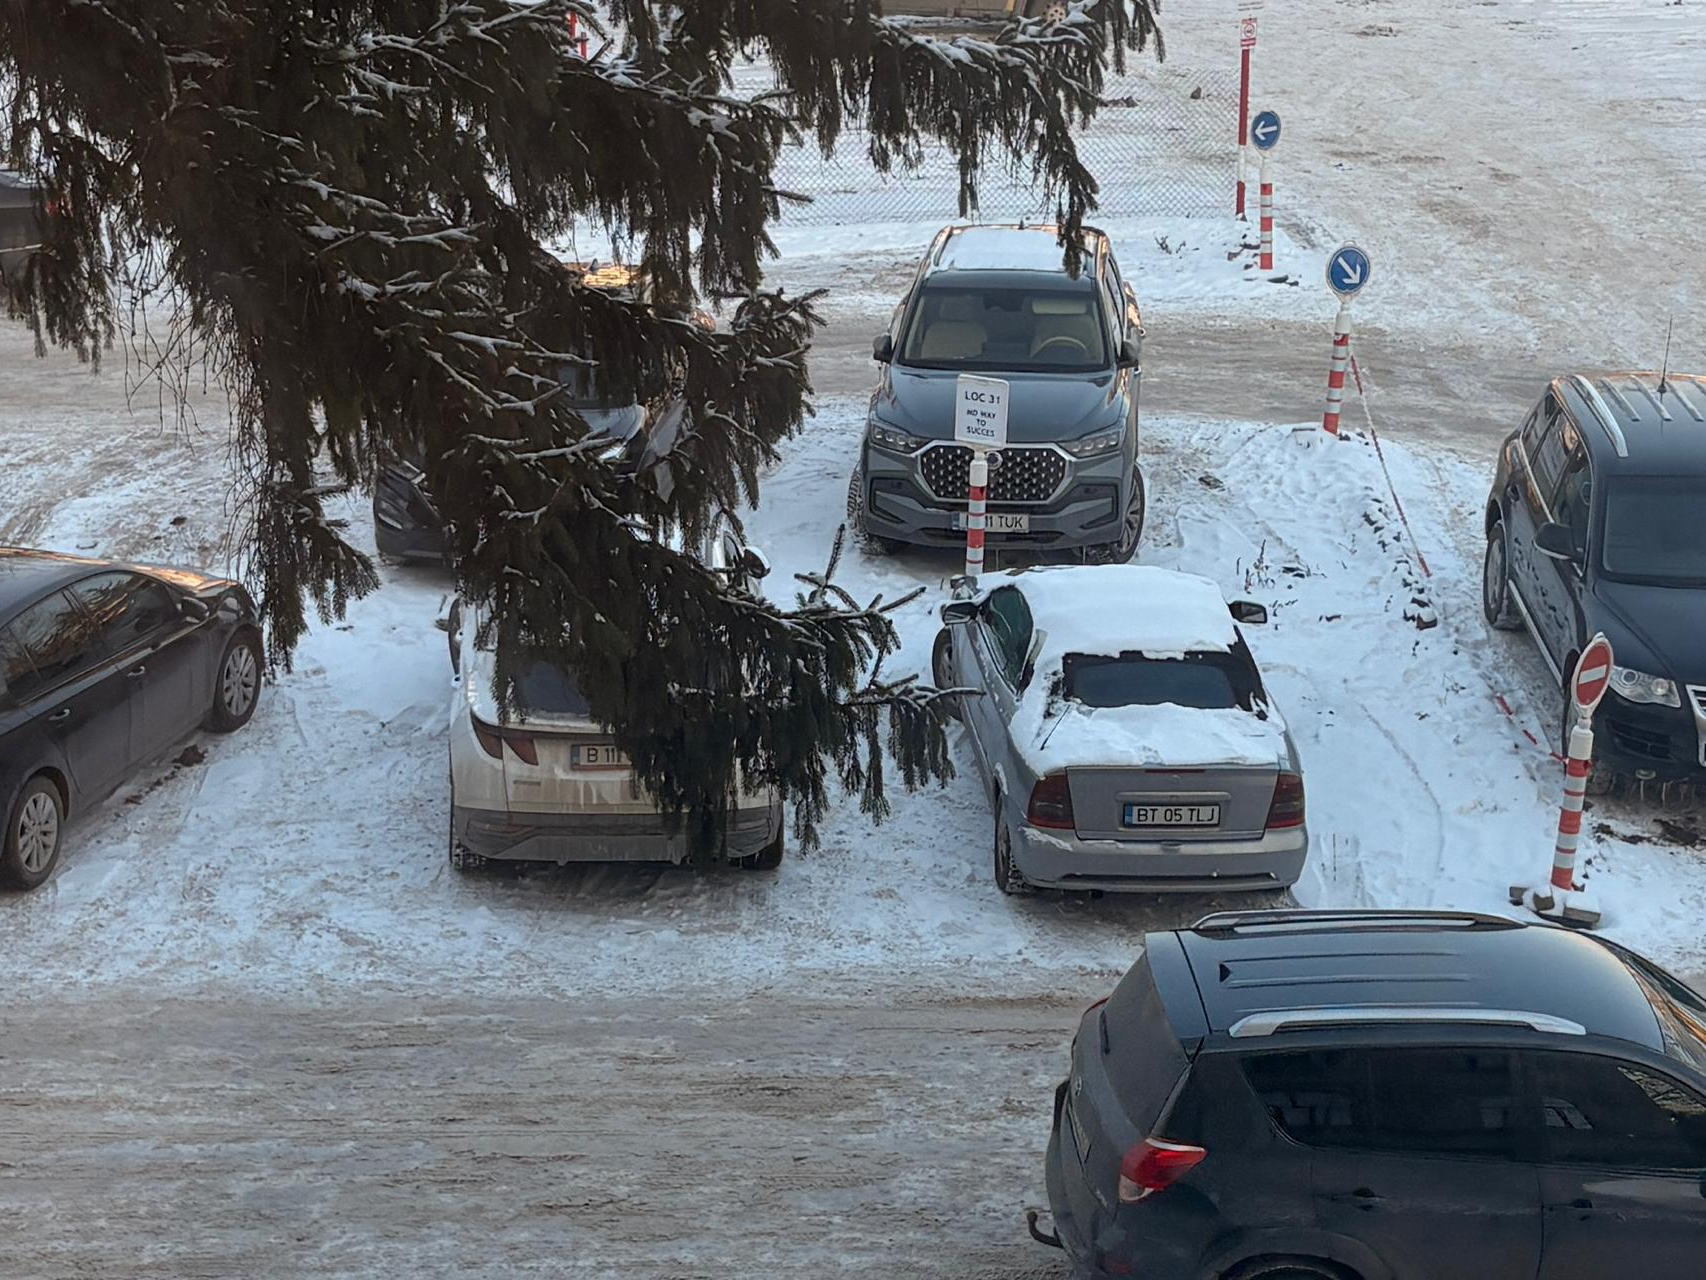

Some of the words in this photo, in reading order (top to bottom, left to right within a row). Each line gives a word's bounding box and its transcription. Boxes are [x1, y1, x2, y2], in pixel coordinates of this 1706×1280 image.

[965, 391, 986, 403] LOC
[998, 516, 1023, 529] TUK
[587, 747, 598, 763] B
[1137, 808, 1158, 822] BT
[1164, 808, 1183, 822] 05
[1188, 808, 1215, 822] TLJ
